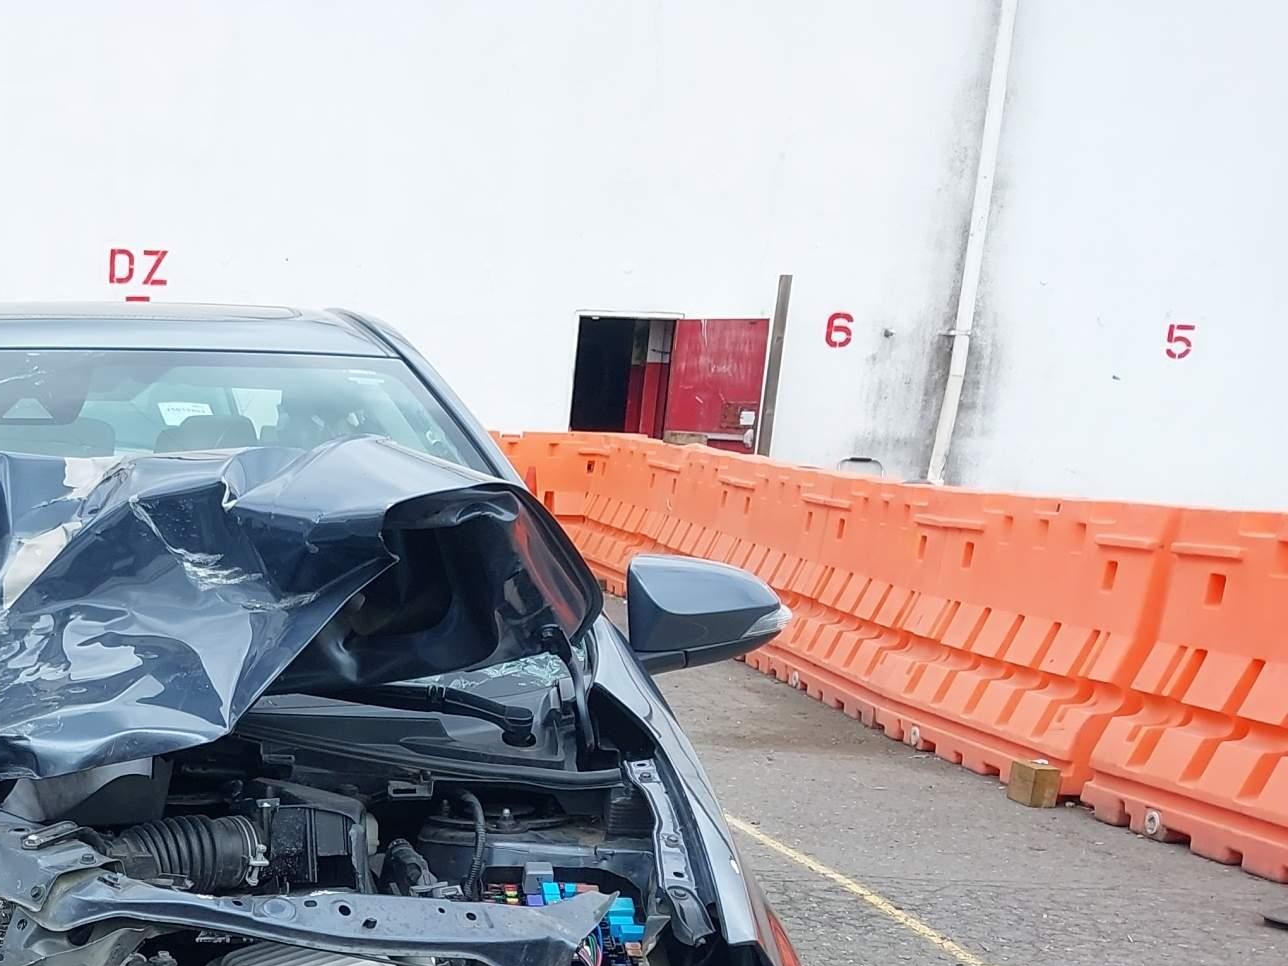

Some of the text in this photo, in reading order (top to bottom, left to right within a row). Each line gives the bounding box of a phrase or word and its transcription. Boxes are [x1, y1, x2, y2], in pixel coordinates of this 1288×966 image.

[108, 247, 168, 286] DZ
[824, 312, 854, 349] 6
[1166, 325, 1195, 359] 5
